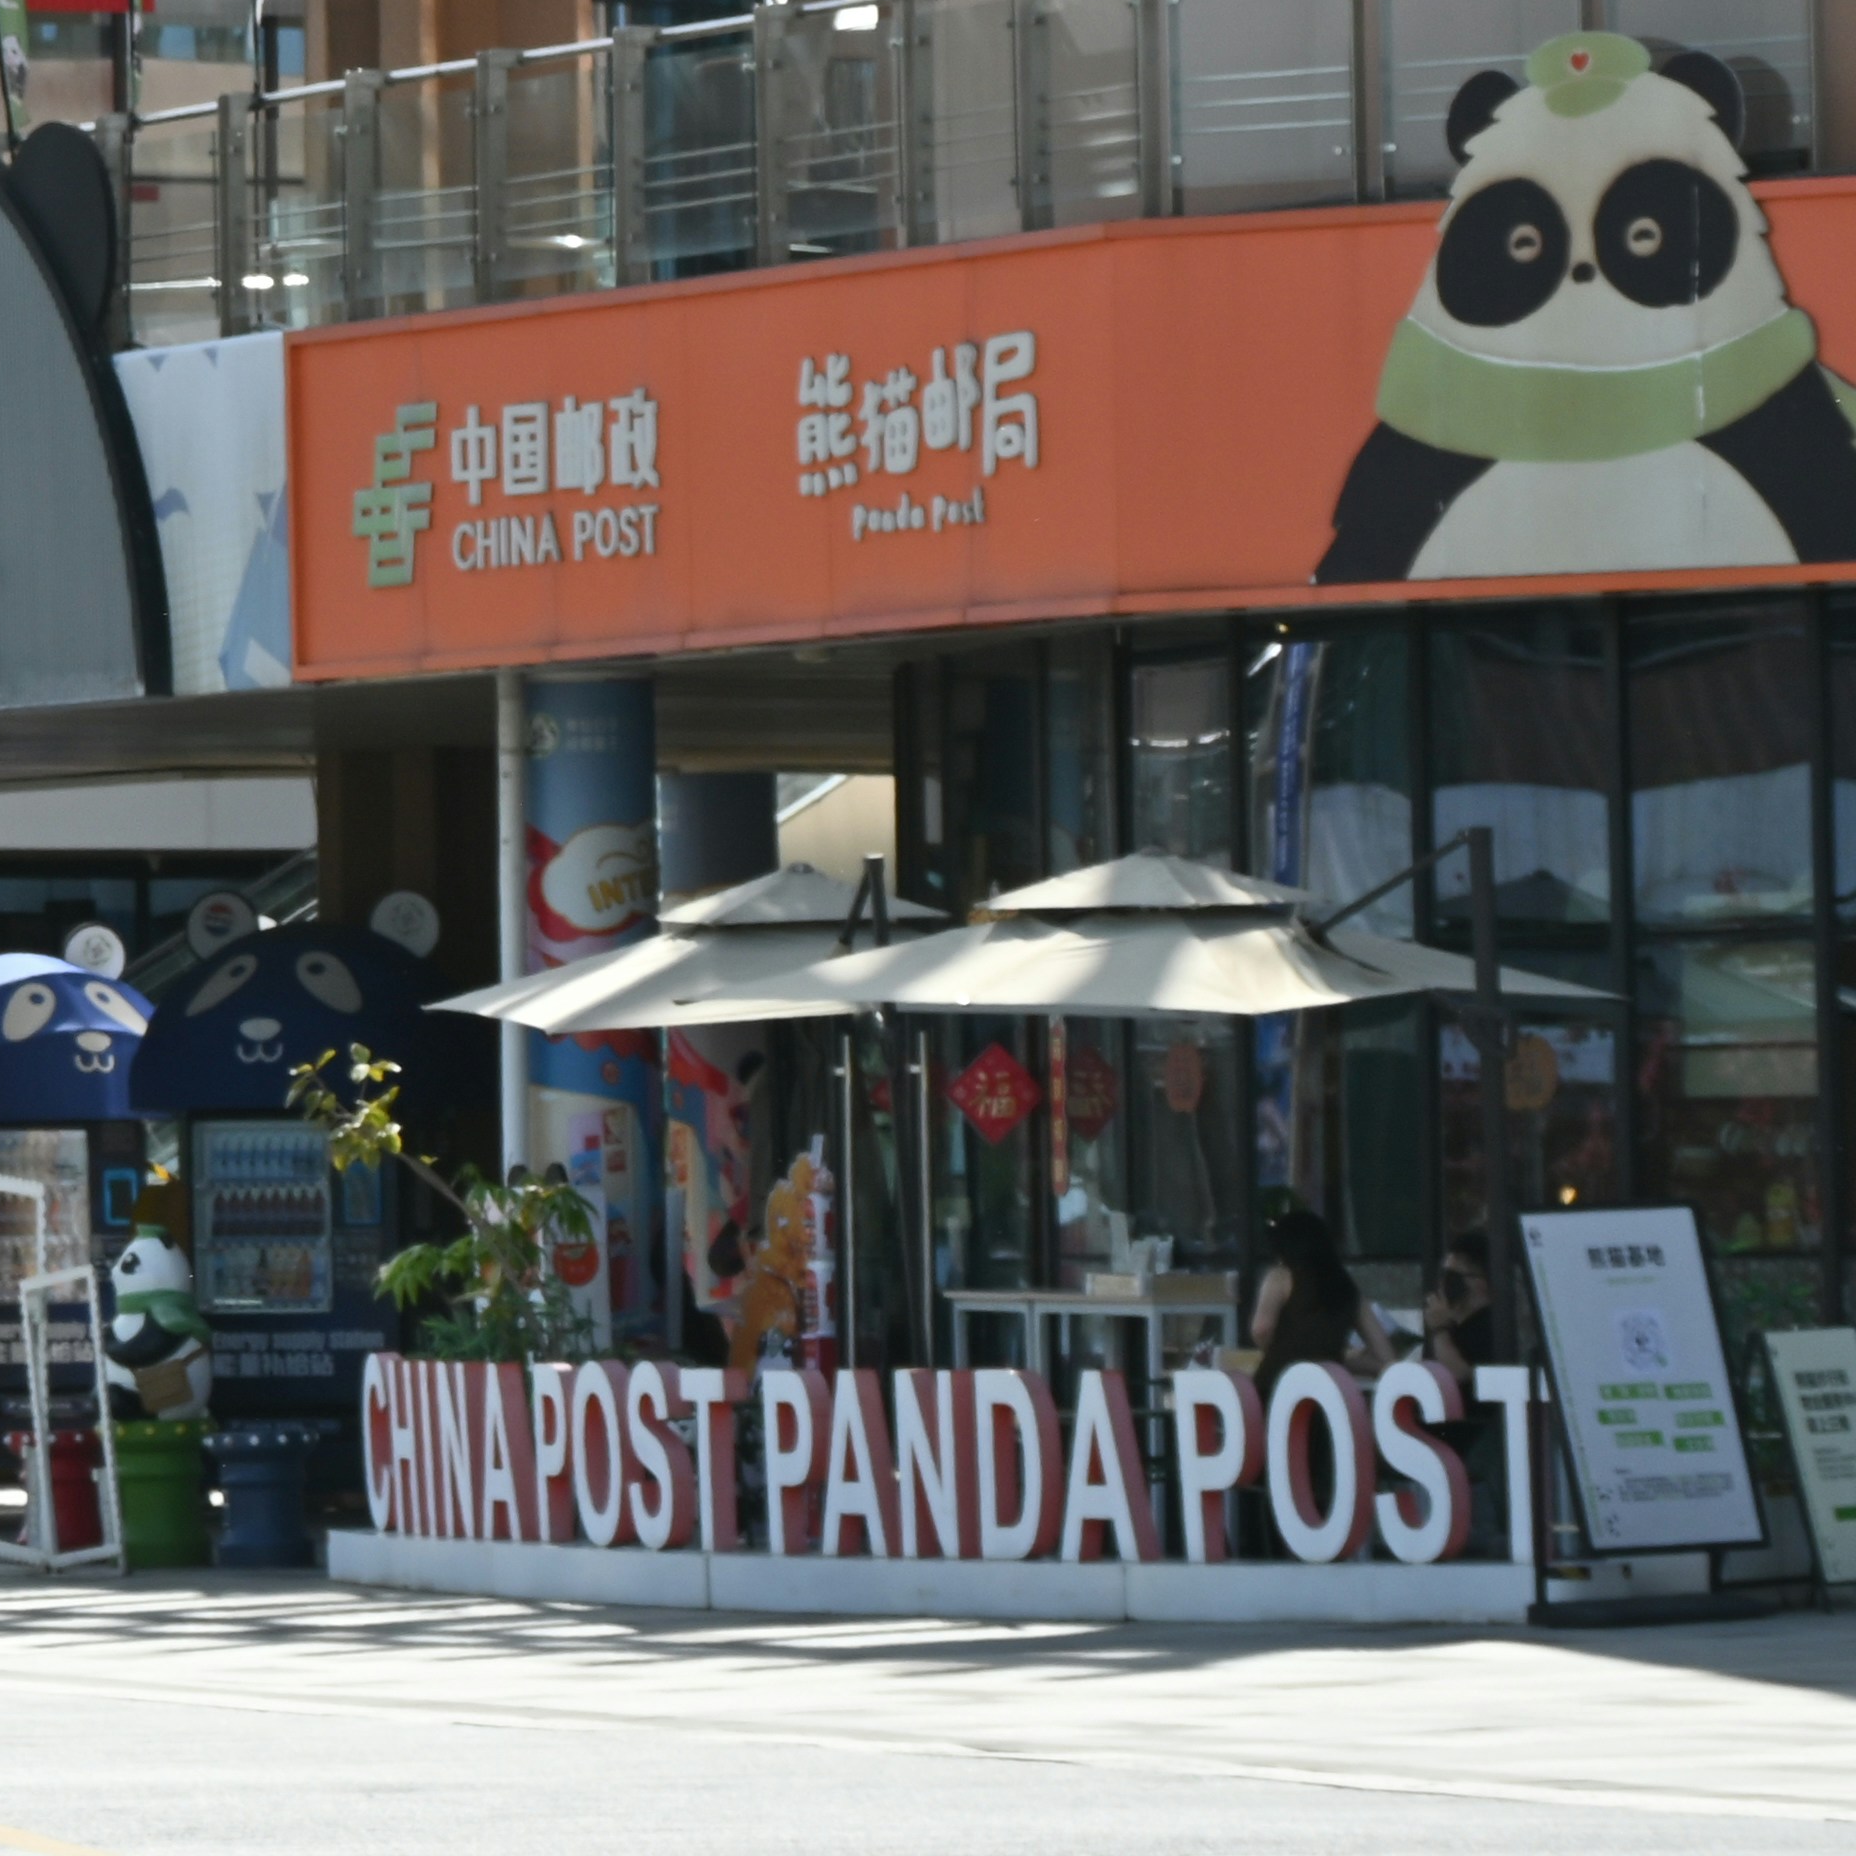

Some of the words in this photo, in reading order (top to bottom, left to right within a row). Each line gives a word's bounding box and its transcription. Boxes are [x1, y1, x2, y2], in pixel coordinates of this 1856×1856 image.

[451, 387, 661, 507] 中国邮政
[798, 330, 1040, 497] 熊猫邮局
[452, 514, 563, 571] CHINA
[573, 504, 660, 563] POST
[362, 1352, 526, 1541] CHINA
[533, 1359, 733, 1552] POST
[763, 1367, 1144, 1563] PANDA
[1173, 1360, 1550, 1564] POST
